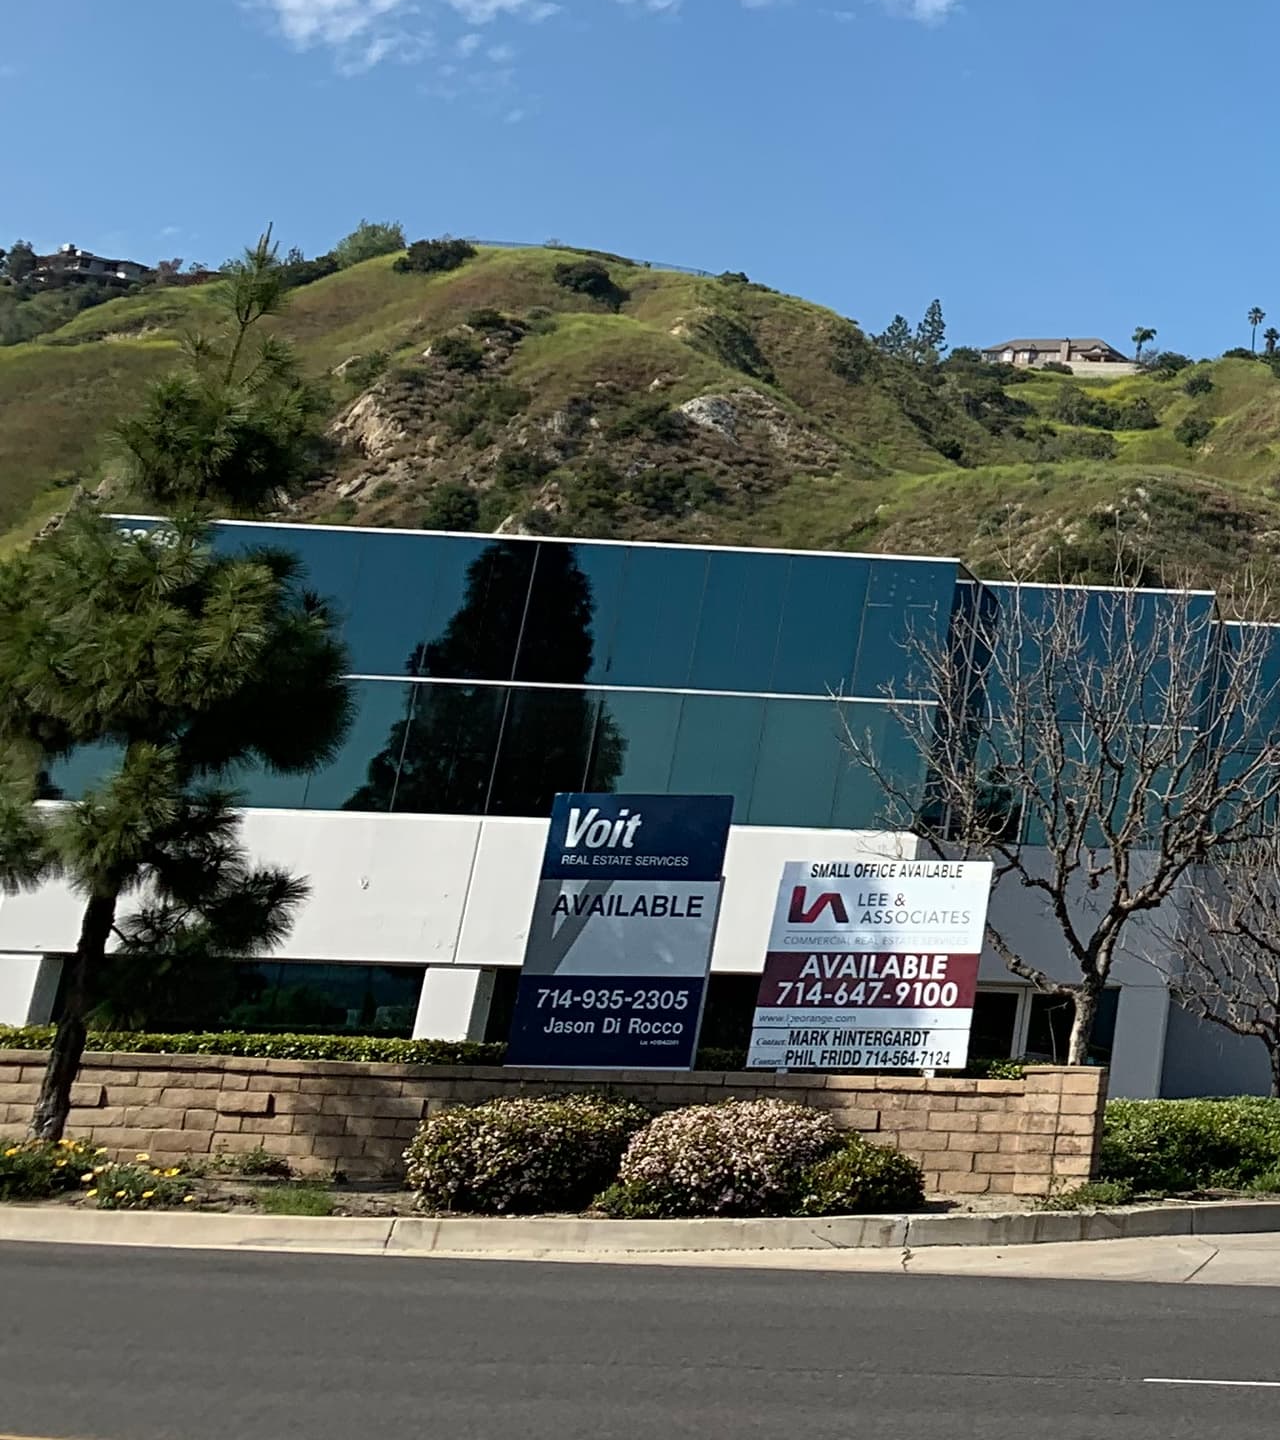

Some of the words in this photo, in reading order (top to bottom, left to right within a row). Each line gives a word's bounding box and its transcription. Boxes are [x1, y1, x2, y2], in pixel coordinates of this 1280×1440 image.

[565, 808, 642, 849] Voit
[561, 855, 589, 865] REAL
[592, 855, 632, 866] ESTATE
[634, 855, 689, 867] SERVICES
[811, 863, 850, 878] SMALL
[854, 863, 896, 879] OFFICE
[900, 864, 964, 879] AVAILABLE
[551, 894, 704, 918] AVAILABLE
[858, 893, 889, 907] LEE
[894, 893, 906, 907] &
[860, 910, 971, 925] ASSOCIATES
[783, 935, 851, 946] COMMERCIAL
[855, 936, 880, 947] REAL
[799, 955, 948, 980] AVAILABLE
[537, 989, 689, 1010] 714-935-2305
[776, 982, 958, 1007] 714-647-9100
[543, 1017, 595, 1034] Jason
[602, 1017, 622, 1034] Di
[628, 1018, 684, 1035] Rocco
[788, 1030, 829, 1046] MARK
[832, 1030, 930, 1047] HINTERGARDT
[785, 1050, 816, 1066] PHIL
[820, 1050, 862, 1066] FRIDD
[865, 1051, 951, 1066] 714-564-7124
